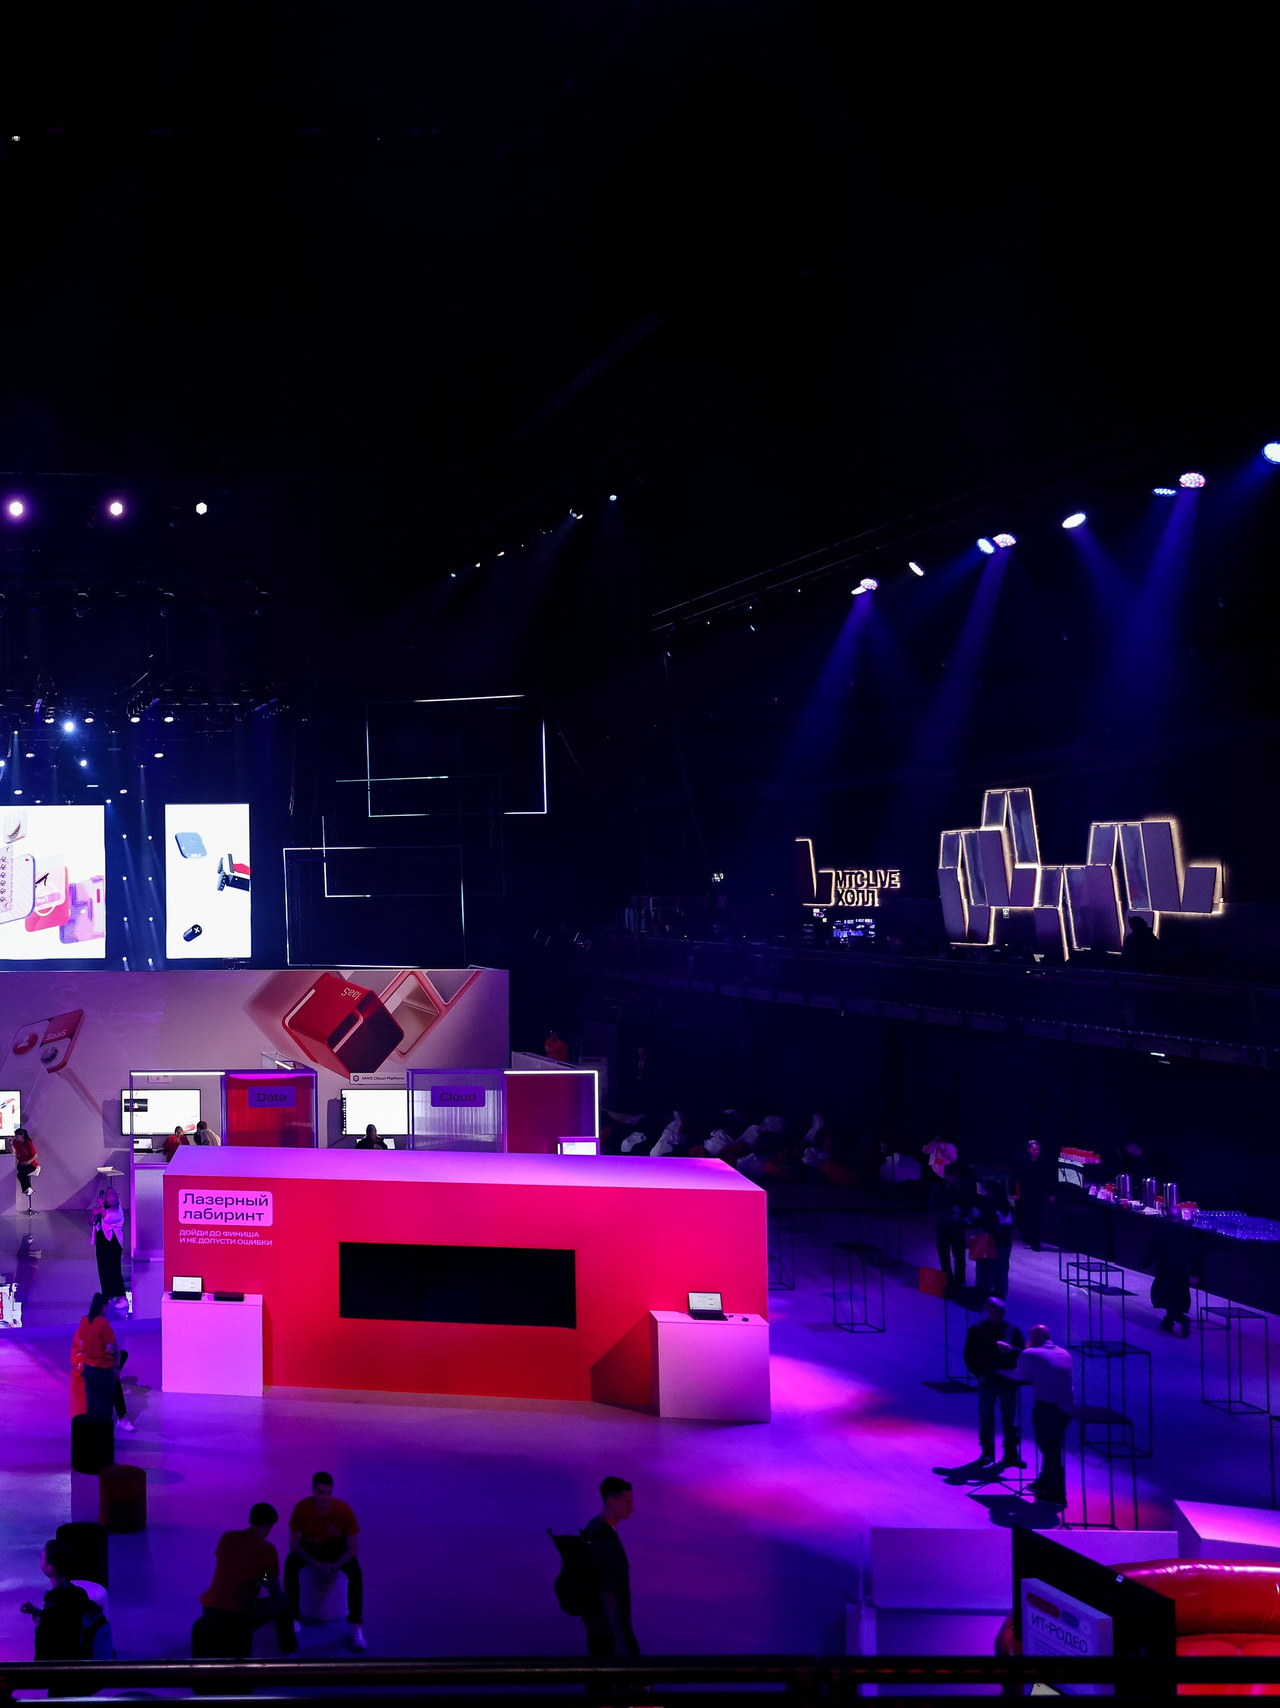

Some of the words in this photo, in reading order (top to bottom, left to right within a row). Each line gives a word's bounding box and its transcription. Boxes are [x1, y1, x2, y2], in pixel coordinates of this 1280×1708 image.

[45, 1029, 68, 1041] SaaS
[256, 1092, 287, 1102] Data
[439, 1092, 477, 1102] Cloud
[182, 1193, 269, 1208] Лазерный
[182, 1208, 265, 1223] лабиринт
[179, 1228, 209, 1237] ДОЙДИ
[222, 1230, 260, 1238] ФИНИША
[236, 1238, 273, 1246] ОШИБКИ
[1031, 1612, 1088, 1654] ИТ-РОДЕО
